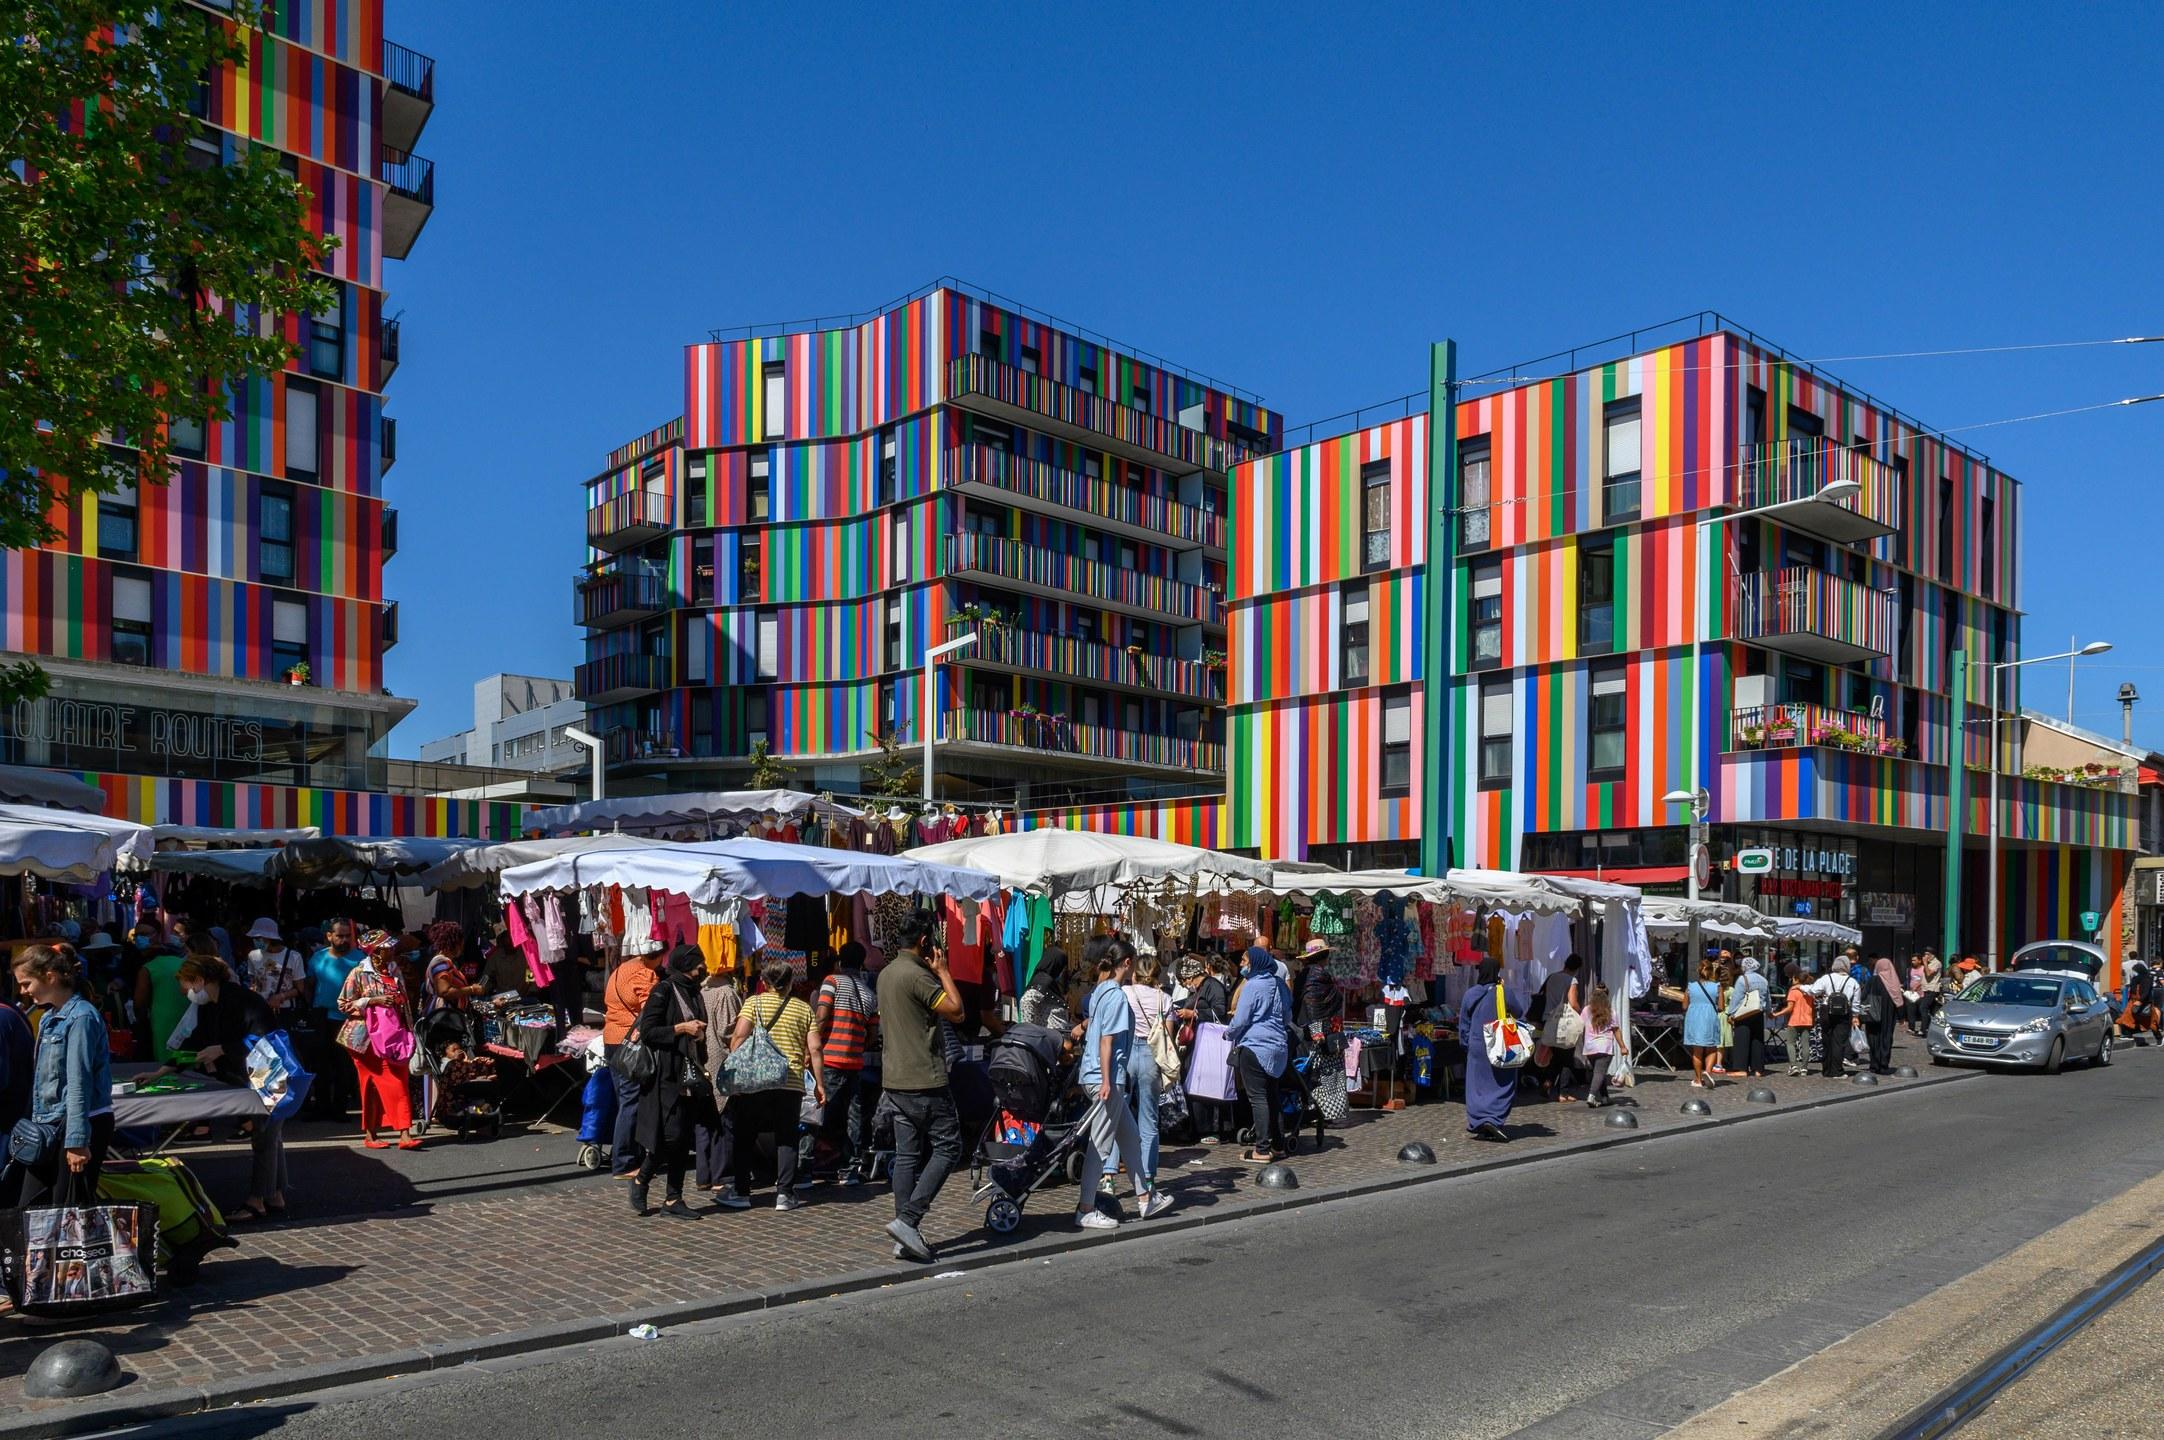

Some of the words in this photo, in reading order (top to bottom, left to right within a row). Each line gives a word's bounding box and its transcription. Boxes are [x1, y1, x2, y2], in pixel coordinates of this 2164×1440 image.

[13, 696, 137, 752] QUATRE
[151, 711, 263, 763] ROUTES
[1786, 848, 1798, 870] DE
[1803, 849, 1815, 872] LA
[1820, 851, 1851, 875] PLACE
[1761, 879, 1777, 895] BAR
